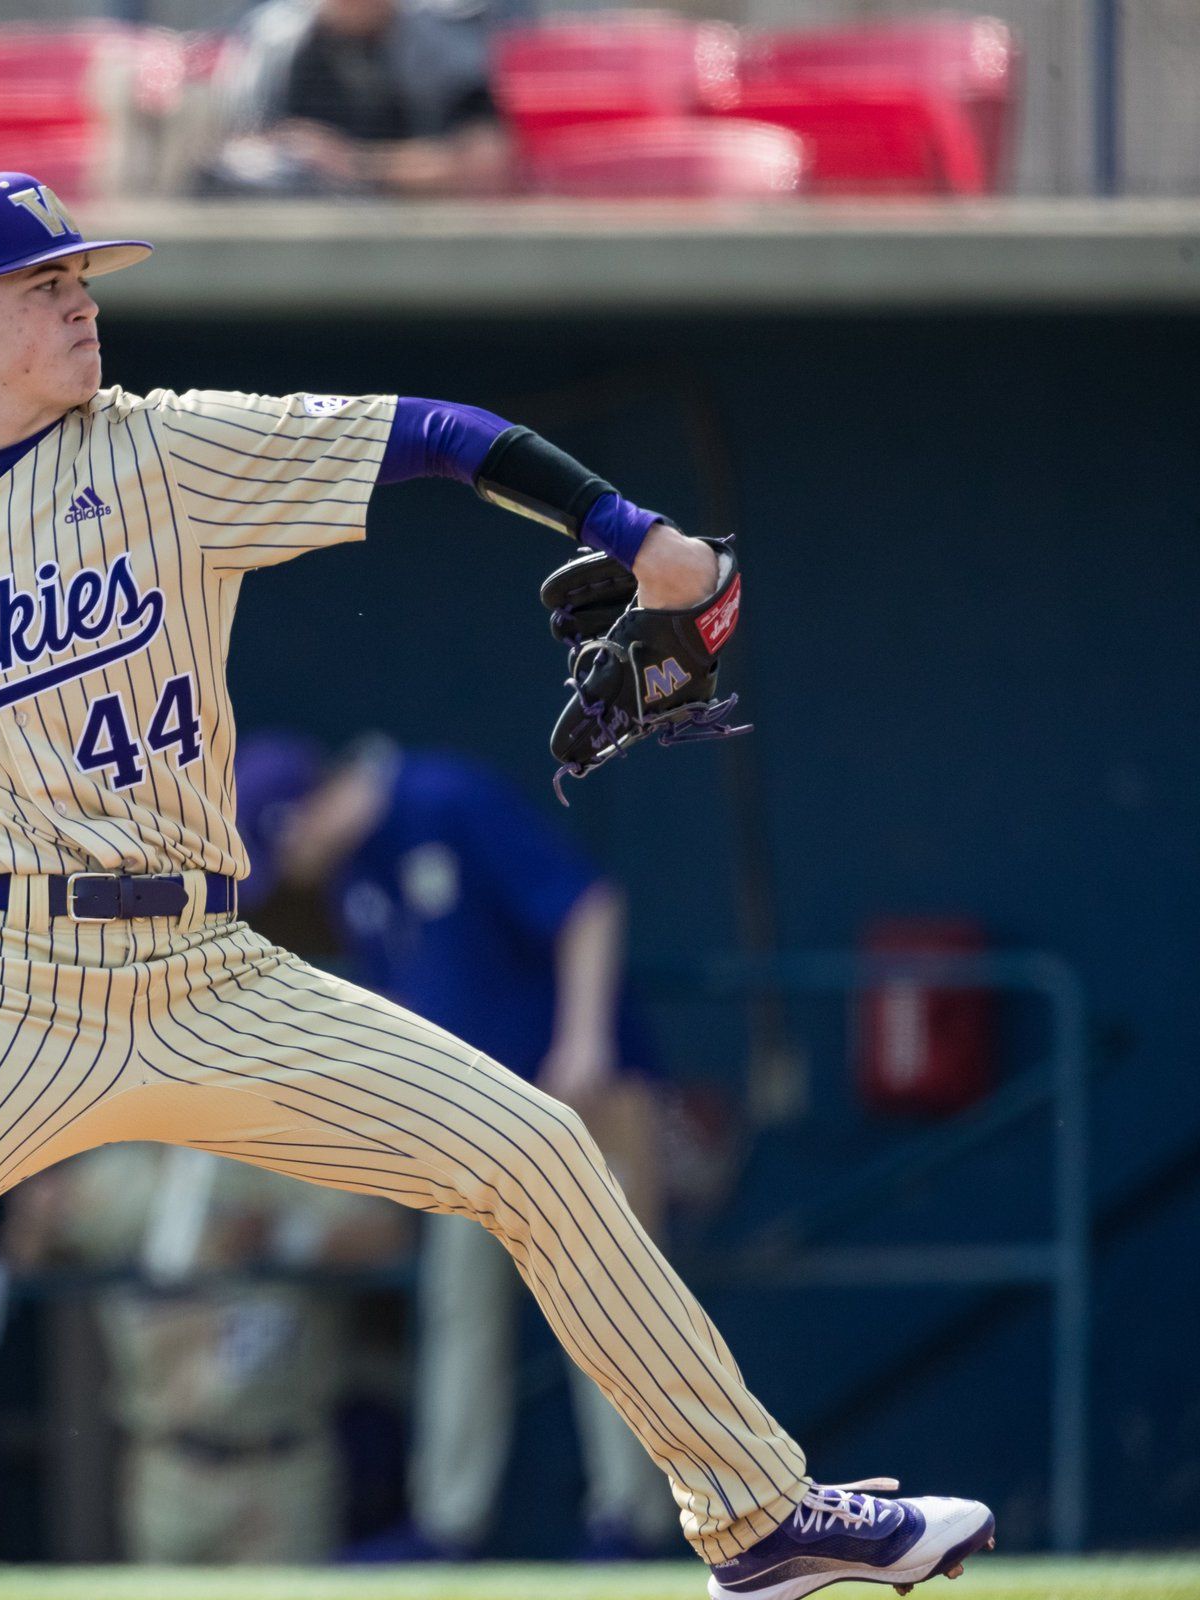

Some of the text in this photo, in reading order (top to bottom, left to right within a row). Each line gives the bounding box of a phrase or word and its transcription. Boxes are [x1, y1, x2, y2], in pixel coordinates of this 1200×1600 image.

[7, 184, 81, 238] W
[64, 505, 112, 524] adidas
[73, 671, 204, 793] 44
